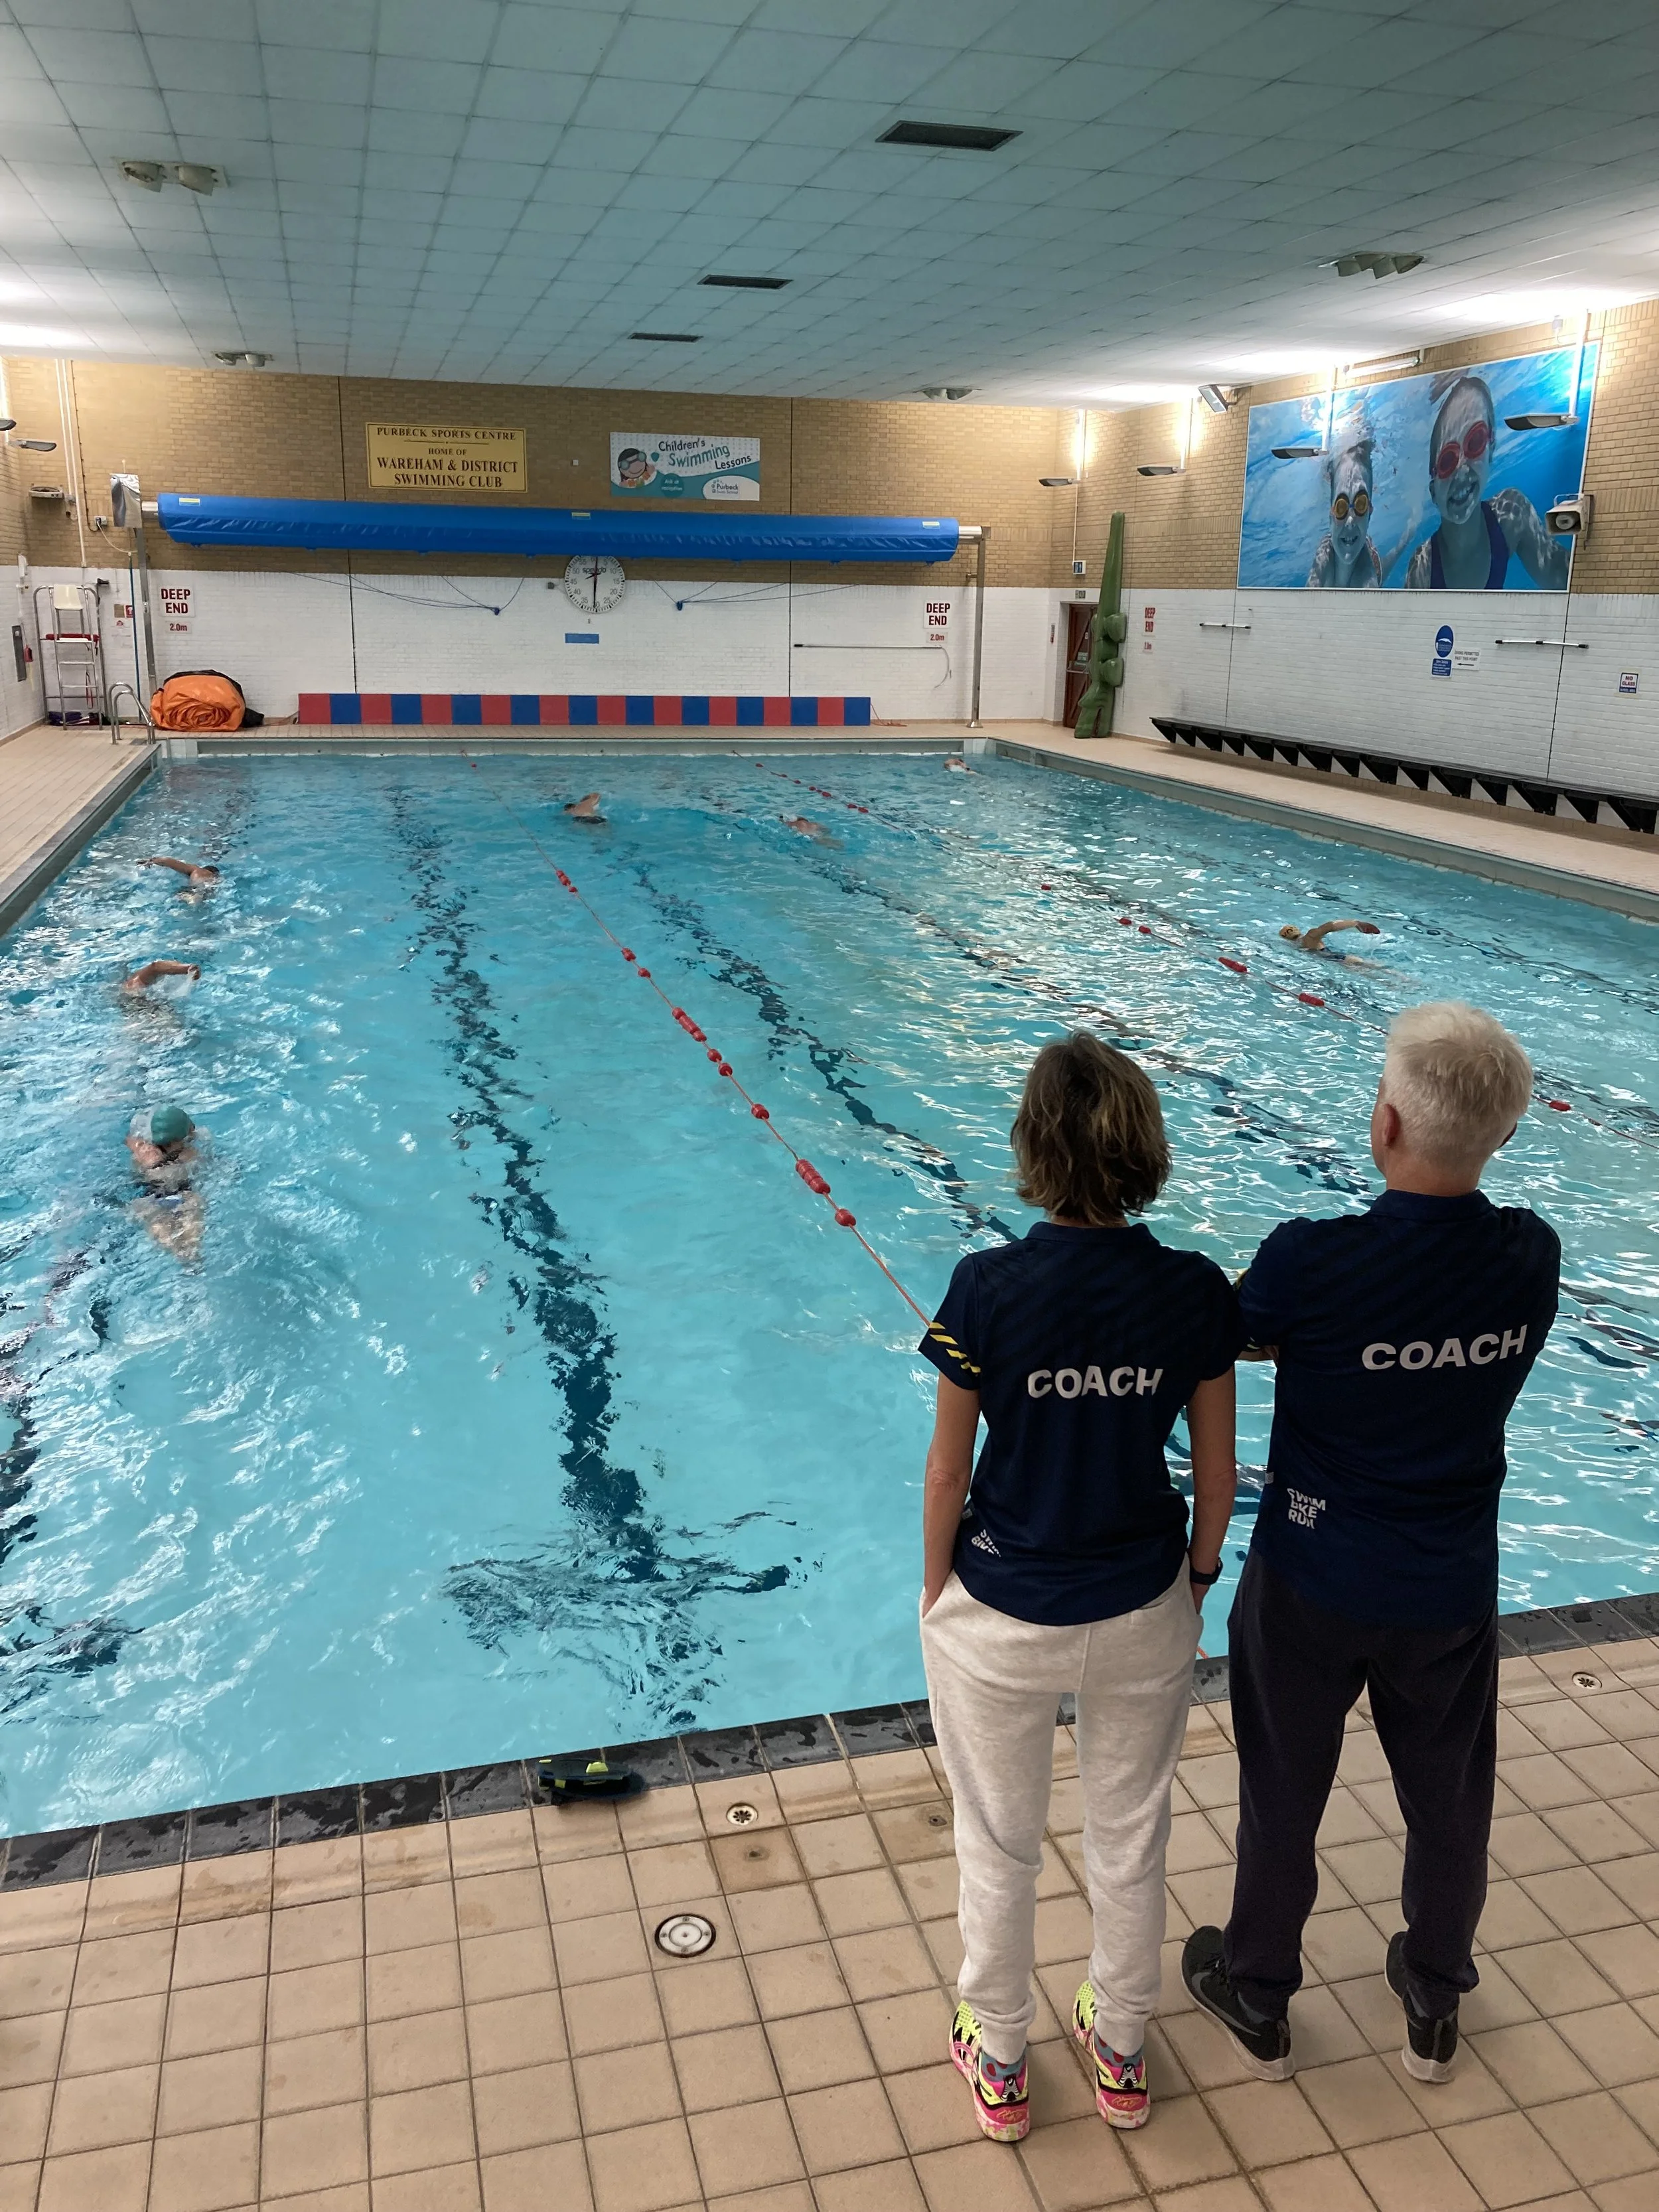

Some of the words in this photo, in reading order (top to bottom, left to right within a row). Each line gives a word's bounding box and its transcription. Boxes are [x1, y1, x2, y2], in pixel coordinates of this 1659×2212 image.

[377, 427, 427, 437] PURBECK
[431, 429, 470, 439] SPORTS
[474, 431, 516, 440] CENTRE
[658, 437, 705, 451] Children's
[668, 444, 730, 467] Swimming
[715, 455, 751, 470] Lessons
[377, 457, 443, 471] WAREHAM
[447, 460, 457, 471] &
[461, 460, 518, 473] DISTRICT
[394, 473, 465, 486] SWIMMING
[469, 476, 502, 487] CLUB
[161, 589, 190, 599] DEEP
[165, 603, 188, 613] END
[926, 603, 950, 613] DEEP
[1145, 607, 1155, 619] DEEP
[929, 615, 947, 625] END
[1362, 1324, 1528, 1370] COACH
[1027, 1365, 1163, 1399] COACH
[1287, 1488, 1326, 1511] SWIM
[1288, 1509, 1315, 1529] RUN
